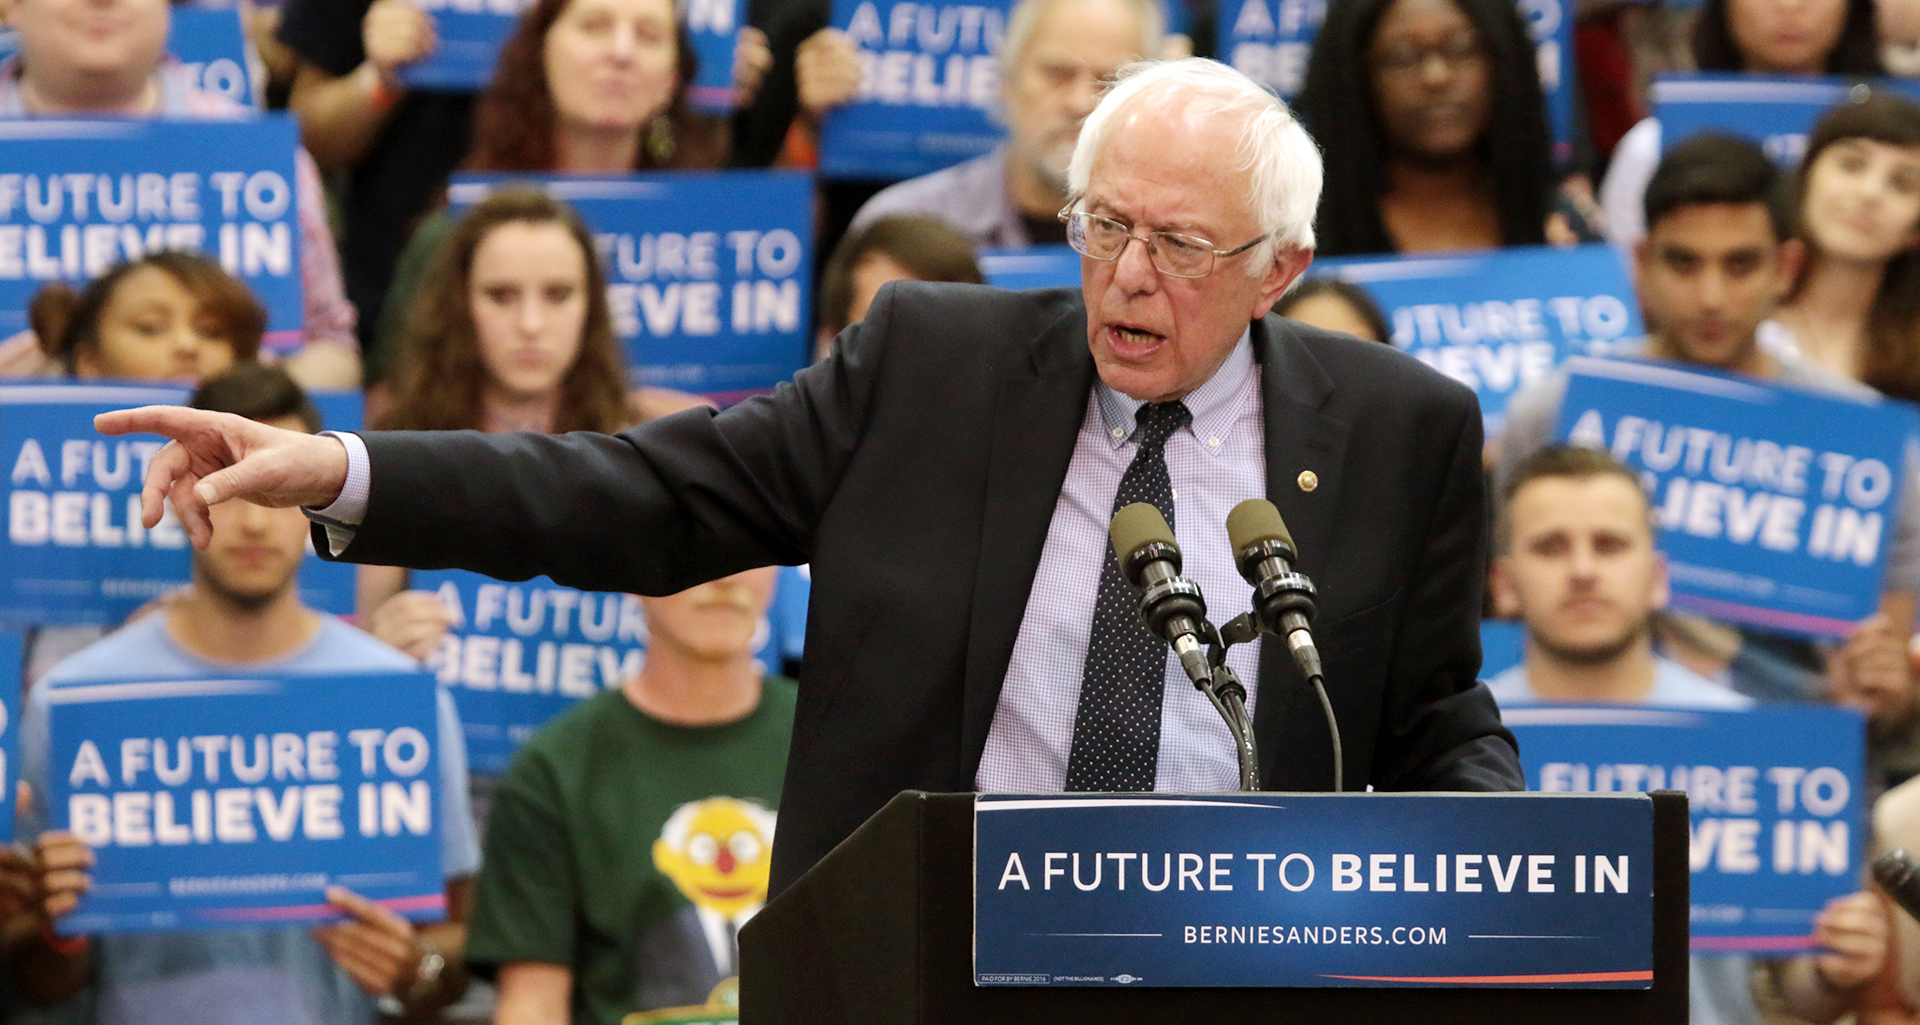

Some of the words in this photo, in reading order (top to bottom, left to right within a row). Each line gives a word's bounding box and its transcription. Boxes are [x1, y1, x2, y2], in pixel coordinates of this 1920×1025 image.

[209, 170, 291, 222] TO
[218, 221, 291, 278] IN
[726, 228, 802, 279] TO
[731, 279, 800, 335] IN
[1549, 294, 1629, 340] TO
[11, 437, 51, 488] A
[1568, 410, 1606, 449] A
[1611, 415, 1814, 497] FUTURE
[1818, 451, 1892, 509] TO
[1807, 503, 1883, 568] IN
[69, 740, 110, 789] A
[121, 731, 341, 787] FUTURE
[348, 725, 431, 778] TO
[69, 783, 345, 847] BELIEVE
[357, 779, 431, 839] IN
[1765, 765, 1850, 818] TO
[998, 852, 1031, 890] A
[1044, 852, 1234, 892] FUTURE
[1246, 852, 1316, 892] TO
[1332, 853, 1556, 893] BELIEVE
[1575, 855, 1629, 893] IN
[1772, 818, 1850, 876] IN
[1184, 926, 1448, 945] BERNIESANDERS.COM
